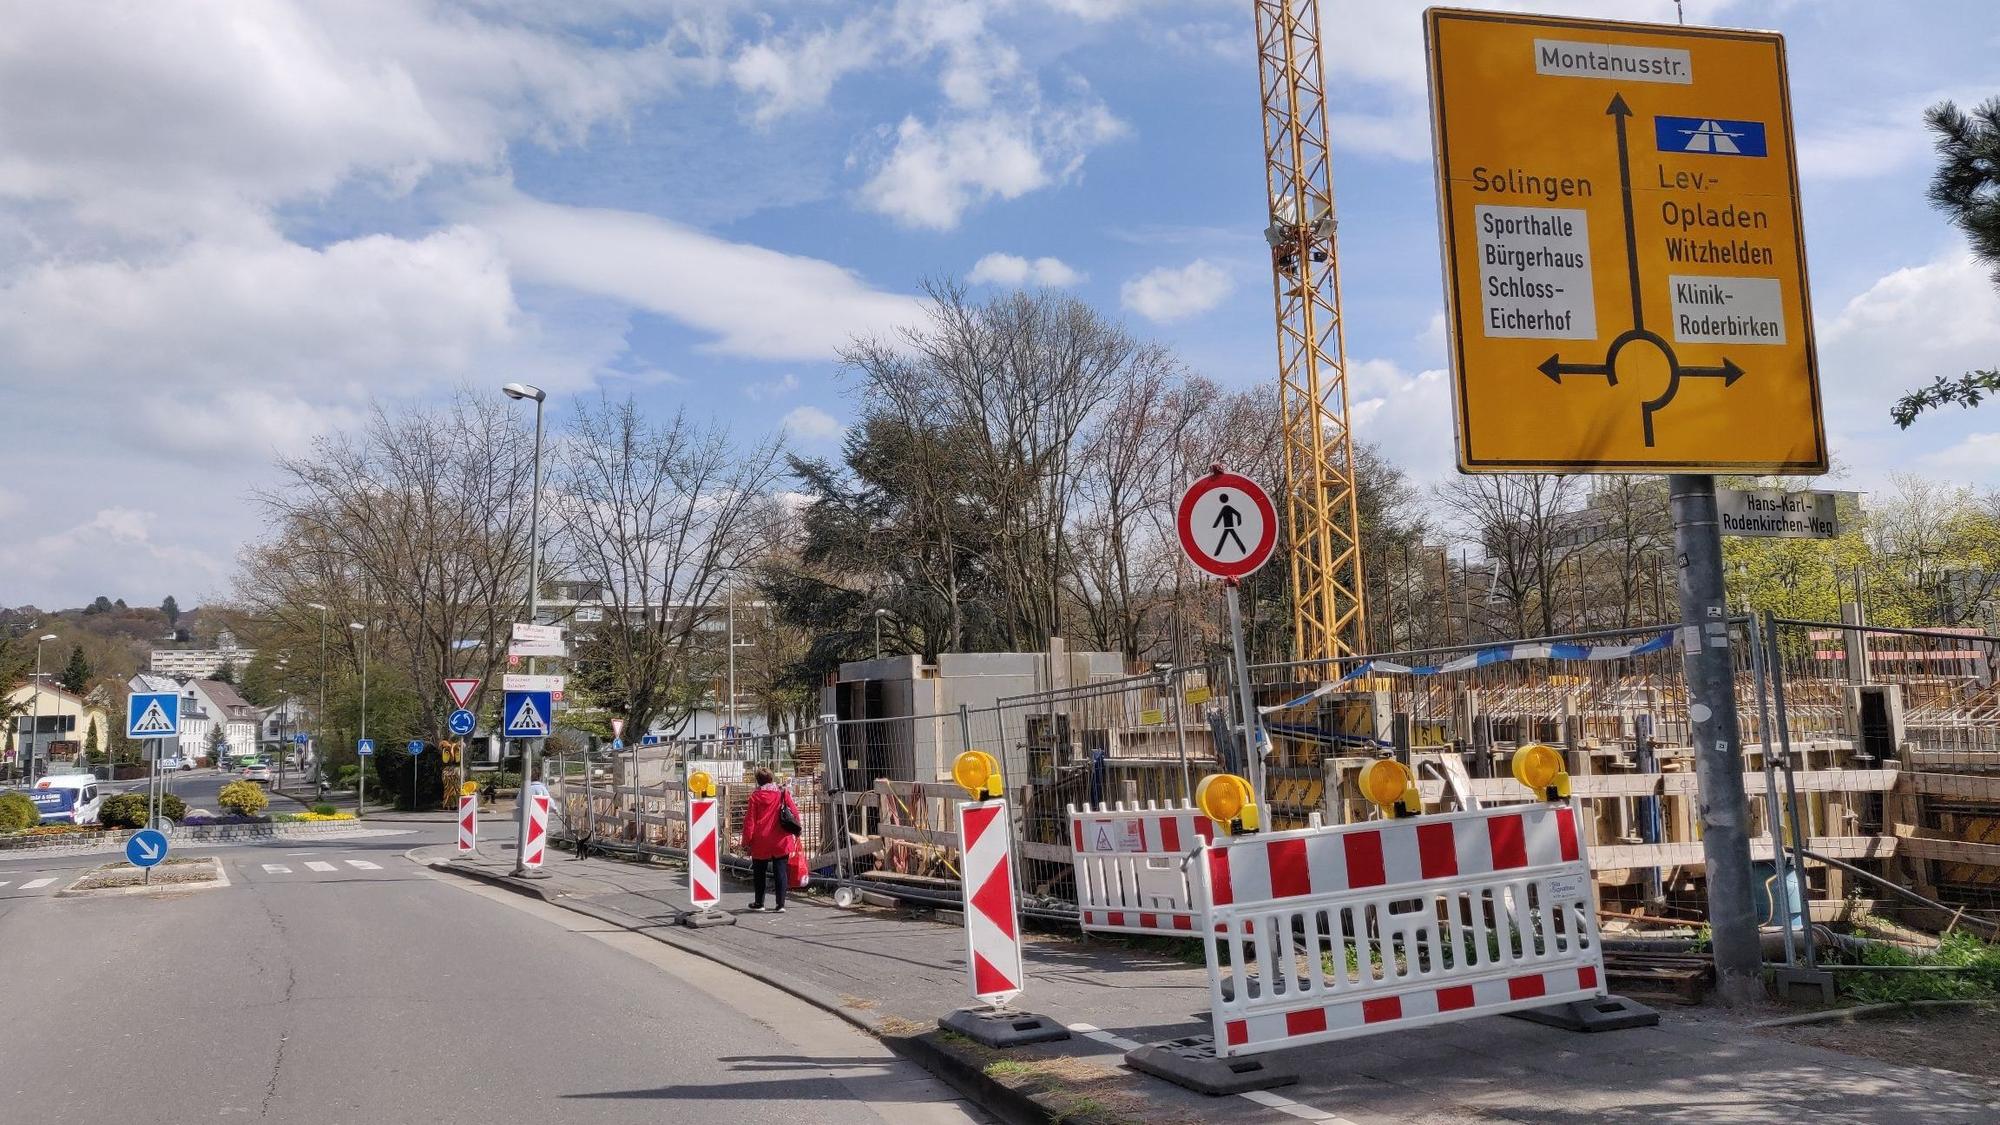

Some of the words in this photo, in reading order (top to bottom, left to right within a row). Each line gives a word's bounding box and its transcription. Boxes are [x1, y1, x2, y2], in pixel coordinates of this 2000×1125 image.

[1541, 47, 1686, 76] Montanusstr.
[1472, 166, 1592, 201] Solingen
[1658, 164, 1719, 191] Lev.-
[1483, 213, 1573, 239] Sporthalle
[1661, 201, 1768, 233] Opladen
[1485, 243, 1584, 271] Bürgerhaus
[1665, 237, 1774, 265] Witzhelden
[1488, 276, 1565, 299] Schloss-
[1676, 283, 1734, 306] Klinik-
[1490, 306, 1572, 331] Eicherhof
[1679, 314, 1779, 337] Roderbirken
[1747, 494, 1812, 513] Hans-Karl-
[1723, 513, 1833, 537] Rodenkirchen-Weg
